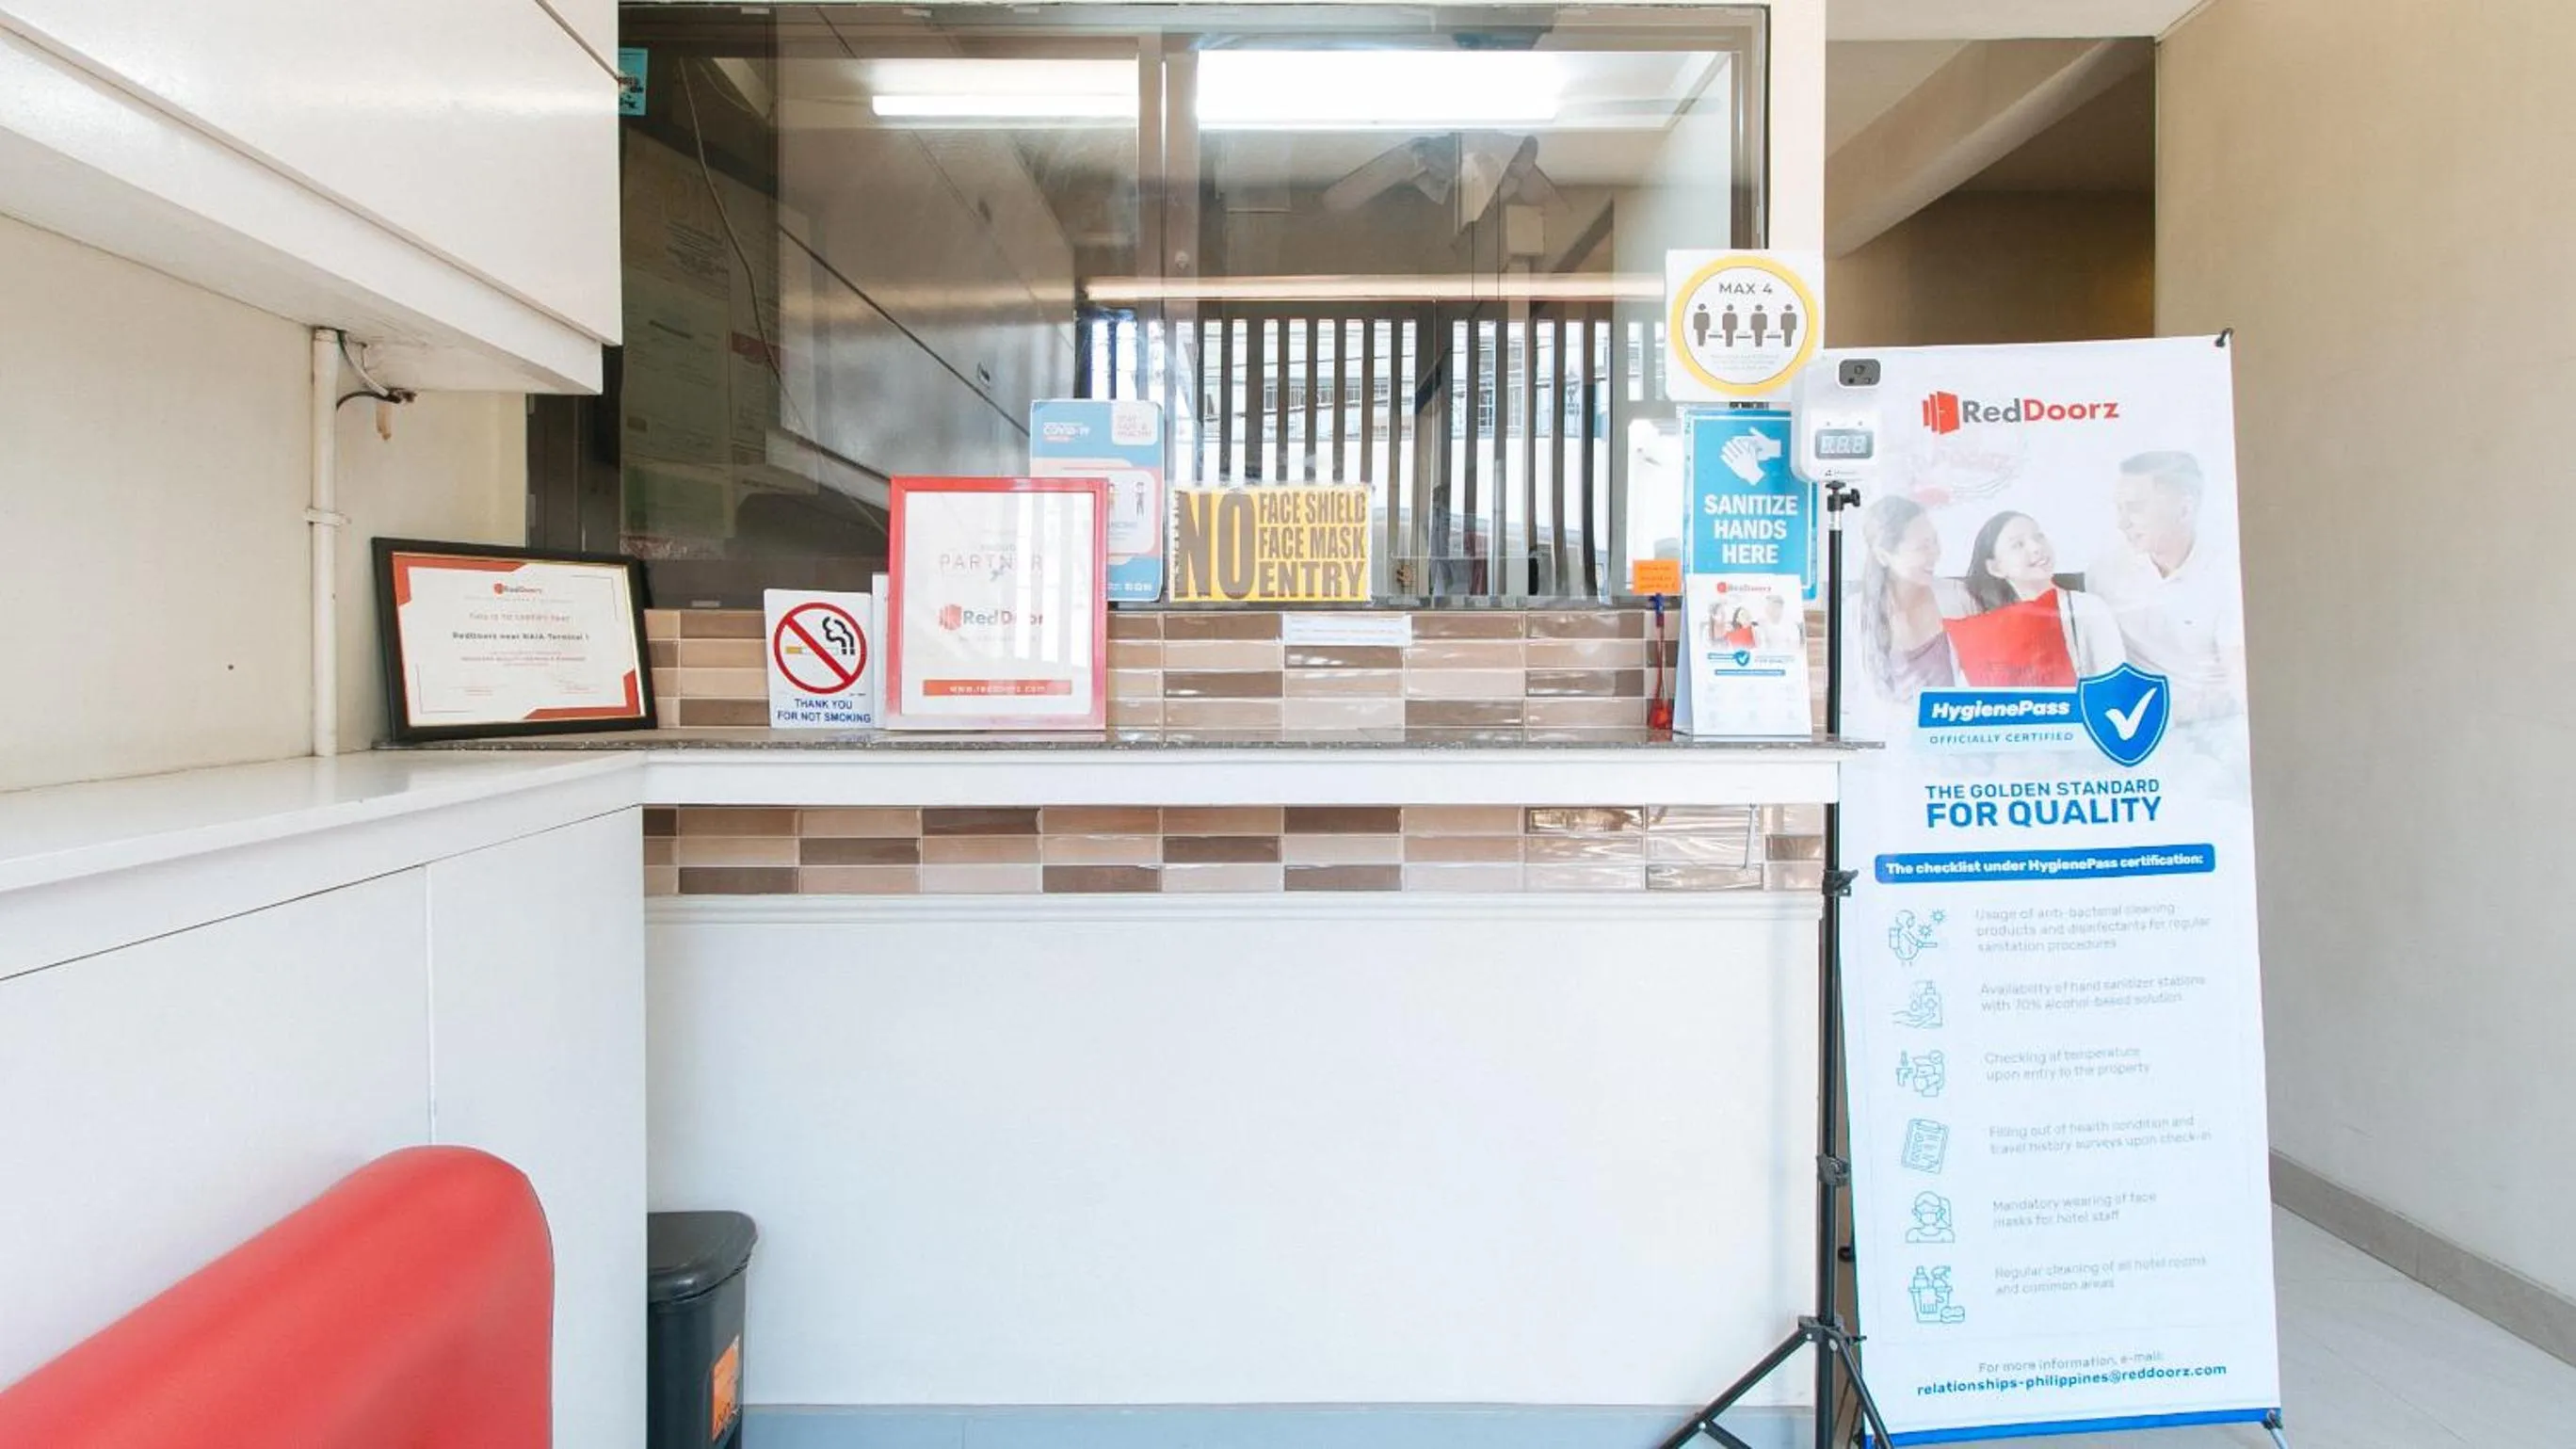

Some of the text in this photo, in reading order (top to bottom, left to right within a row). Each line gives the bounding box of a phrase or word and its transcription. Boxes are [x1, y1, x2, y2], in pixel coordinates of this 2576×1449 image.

[1718, 282, 1773, 295] MAX 4
[1962, 397, 2119, 423] RedDoorz
[1259, 491, 1366, 523] FACE SHIELD
[1704, 494, 1798, 515] SANITIZE
[1714, 519, 1787, 539] HANDS
[1175, 491, 1256, 599] NO
[1259, 527, 1365, 558] FACE MASK
[1722, 543, 1779, 563] HERE
[941, 554, 1043, 570] PARTNR
[1259, 561, 1365, 598] ENTRY
[795, 698, 853, 710] THANK YOU
[1930, 699, 2070, 723] HygienePass
[777, 710, 871, 724] FOR NOT SMOKING
[1929, 731, 2074, 745] OFFICIALLY CERTIFIED
[1925, 779, 2160, 799] THE GOLDEN STANDARD
[1926, 797, 2162, 829] FOR QUALITY
[1885, 853, 2205, 875] The checklist under HygienePass certification:
[1975, 909, 2017, 924] Usage
[2020, 908, 2034, 920] of
[1976, 924, 2037, 938] products
[2040, 923, 2065, 936] and
[2149, 917, 2165, 930] for
[1977, 937, 2117, 954] sanitation procedures
[1981, 974, 2206, 997] Availability of hand sanitizer stations
[1981, 998, 2010, 1012] with
[2133, 991, 2182, 1006] solution
[1984, 1046, 2141, 1066] Checking of temperature
[1986, 1062, 2150, 1083] upon entry to the property
[1988, 1114, 2195, 1139] Filling out of health condition and
[1990, 1131, 2212, 1155] travel history surveys upon check-in
[1992, 1191, 2157, 1213] Mandatory wearing of face
[1993, 1209, 2120, 1229] masks for hotel staff
[1995, 1266, 2042, 1280] Regular
[2101, 1260, 2115, 1273] of
[2133, 1256, 2165, 1271] hotel
[1995, 1282, 2019, 1296] and
[2021, 1280, 2077, 1295] common
[1978, 1361, 1999, 1374] For
[2002, 1360, 2037, 1373] more
[2038, 1356, 2118, 1372] information,
[1917, 1363, 2228, 1397] relationships-philippines@reddoorz.com
